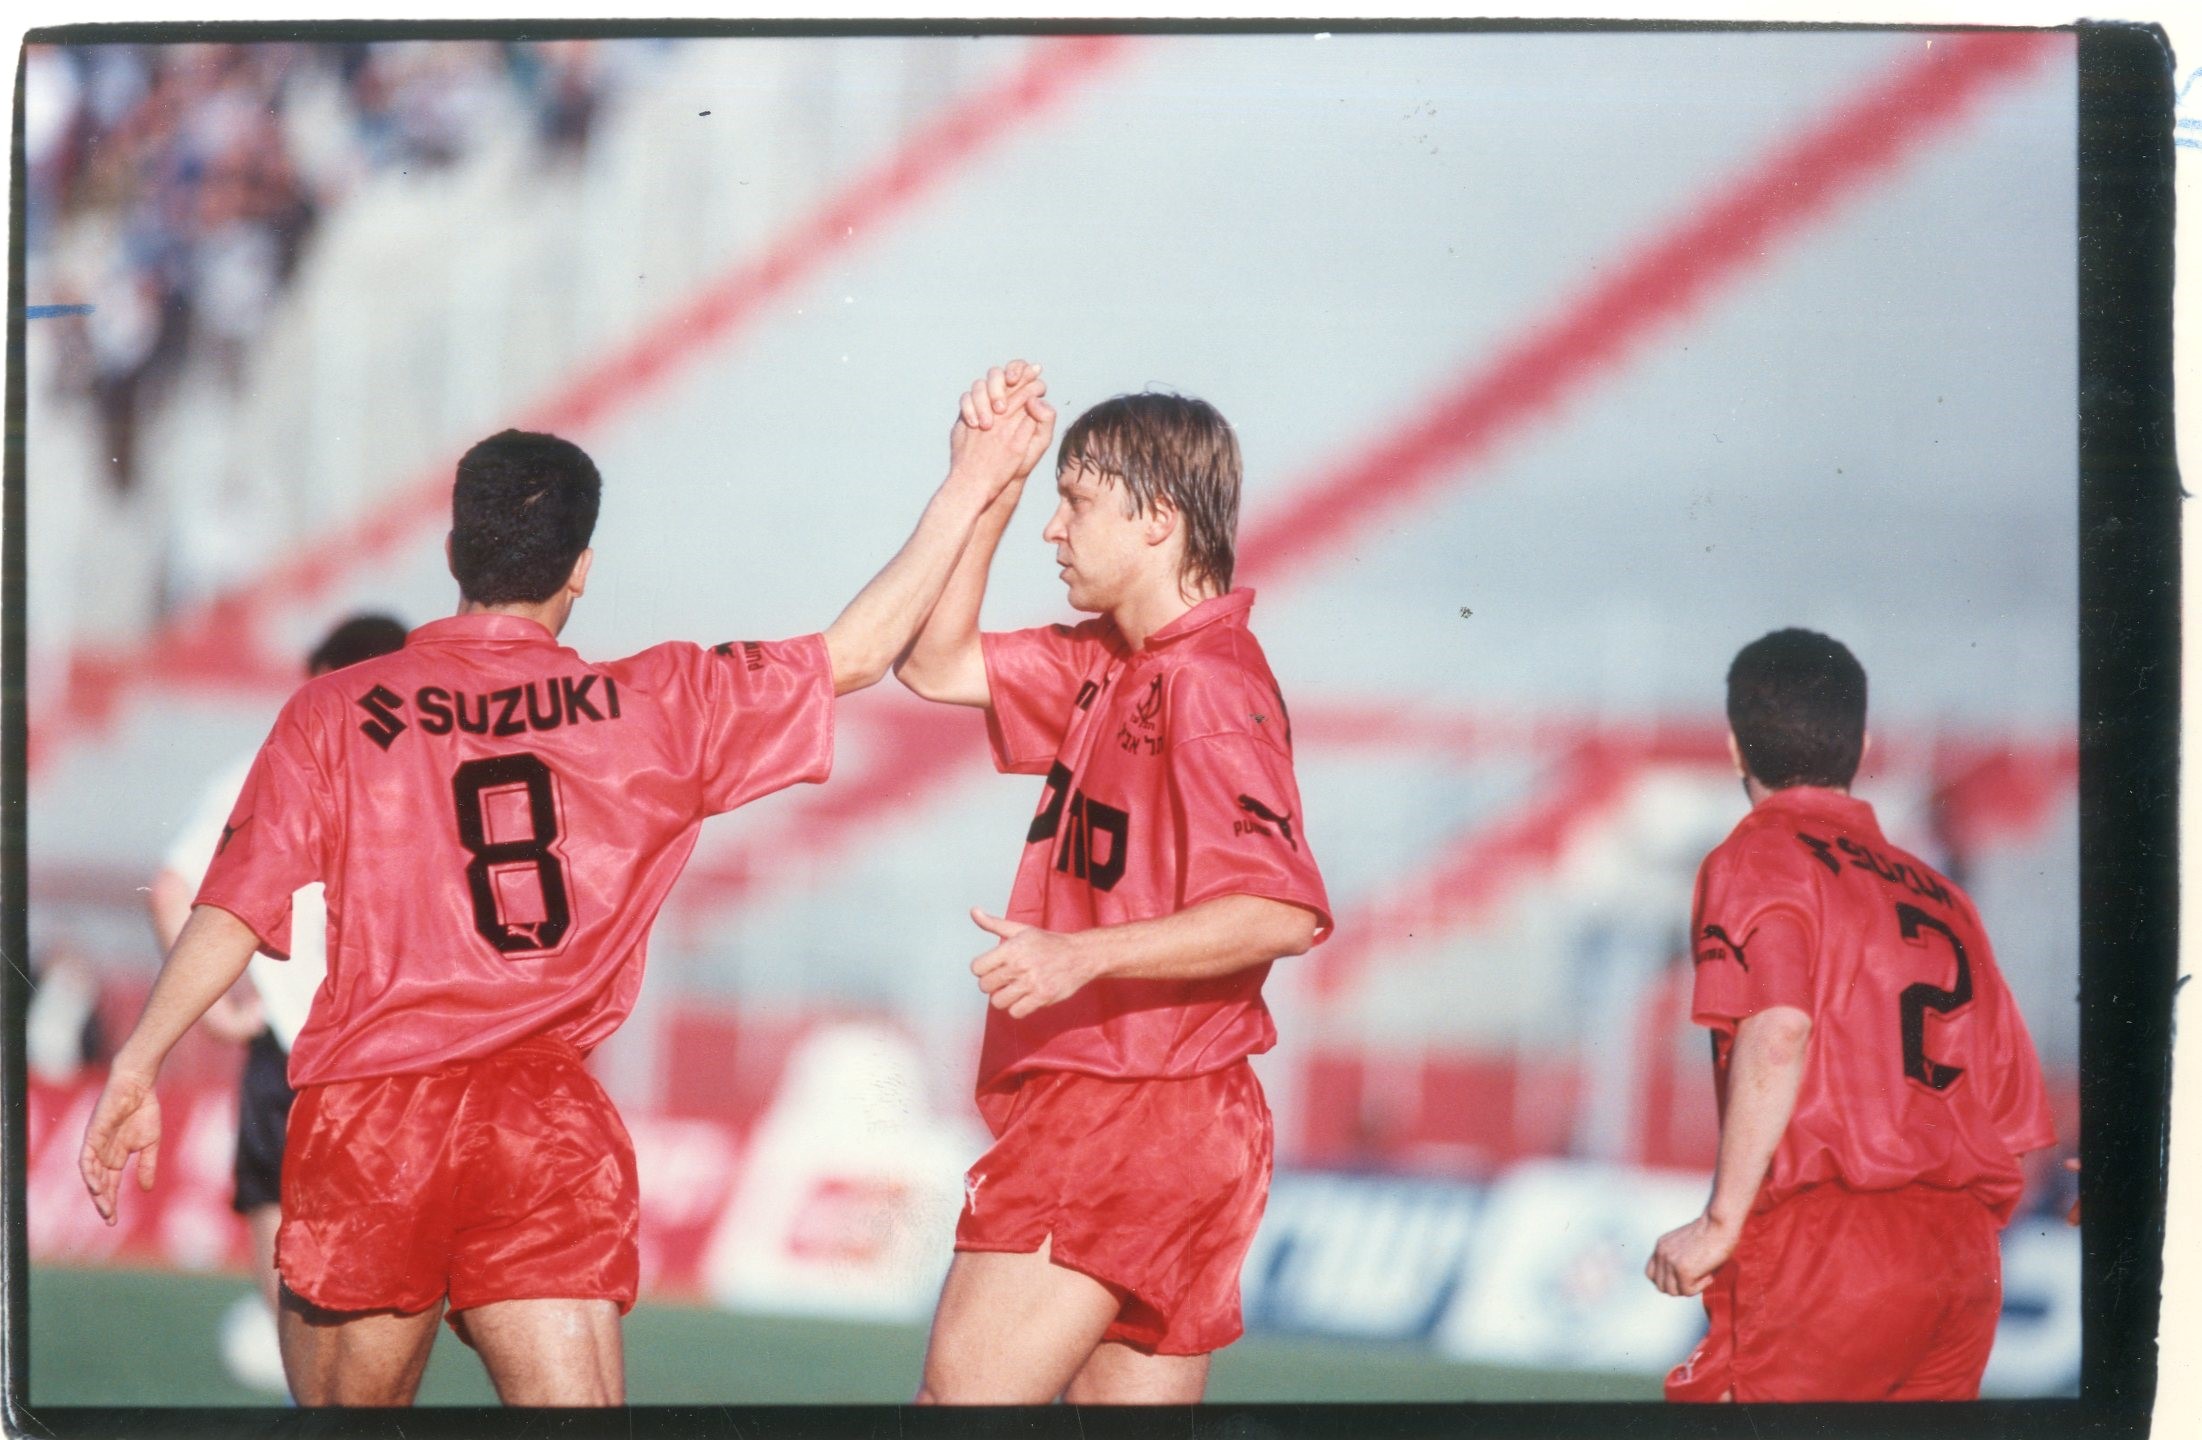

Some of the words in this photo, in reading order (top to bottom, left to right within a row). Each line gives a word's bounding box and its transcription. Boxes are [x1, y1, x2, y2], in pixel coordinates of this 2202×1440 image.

[416, 674, 621, 737] SUZUKI
[452, 752, 575, 956] 8
[1895, 901, 1972, 1090] 2
